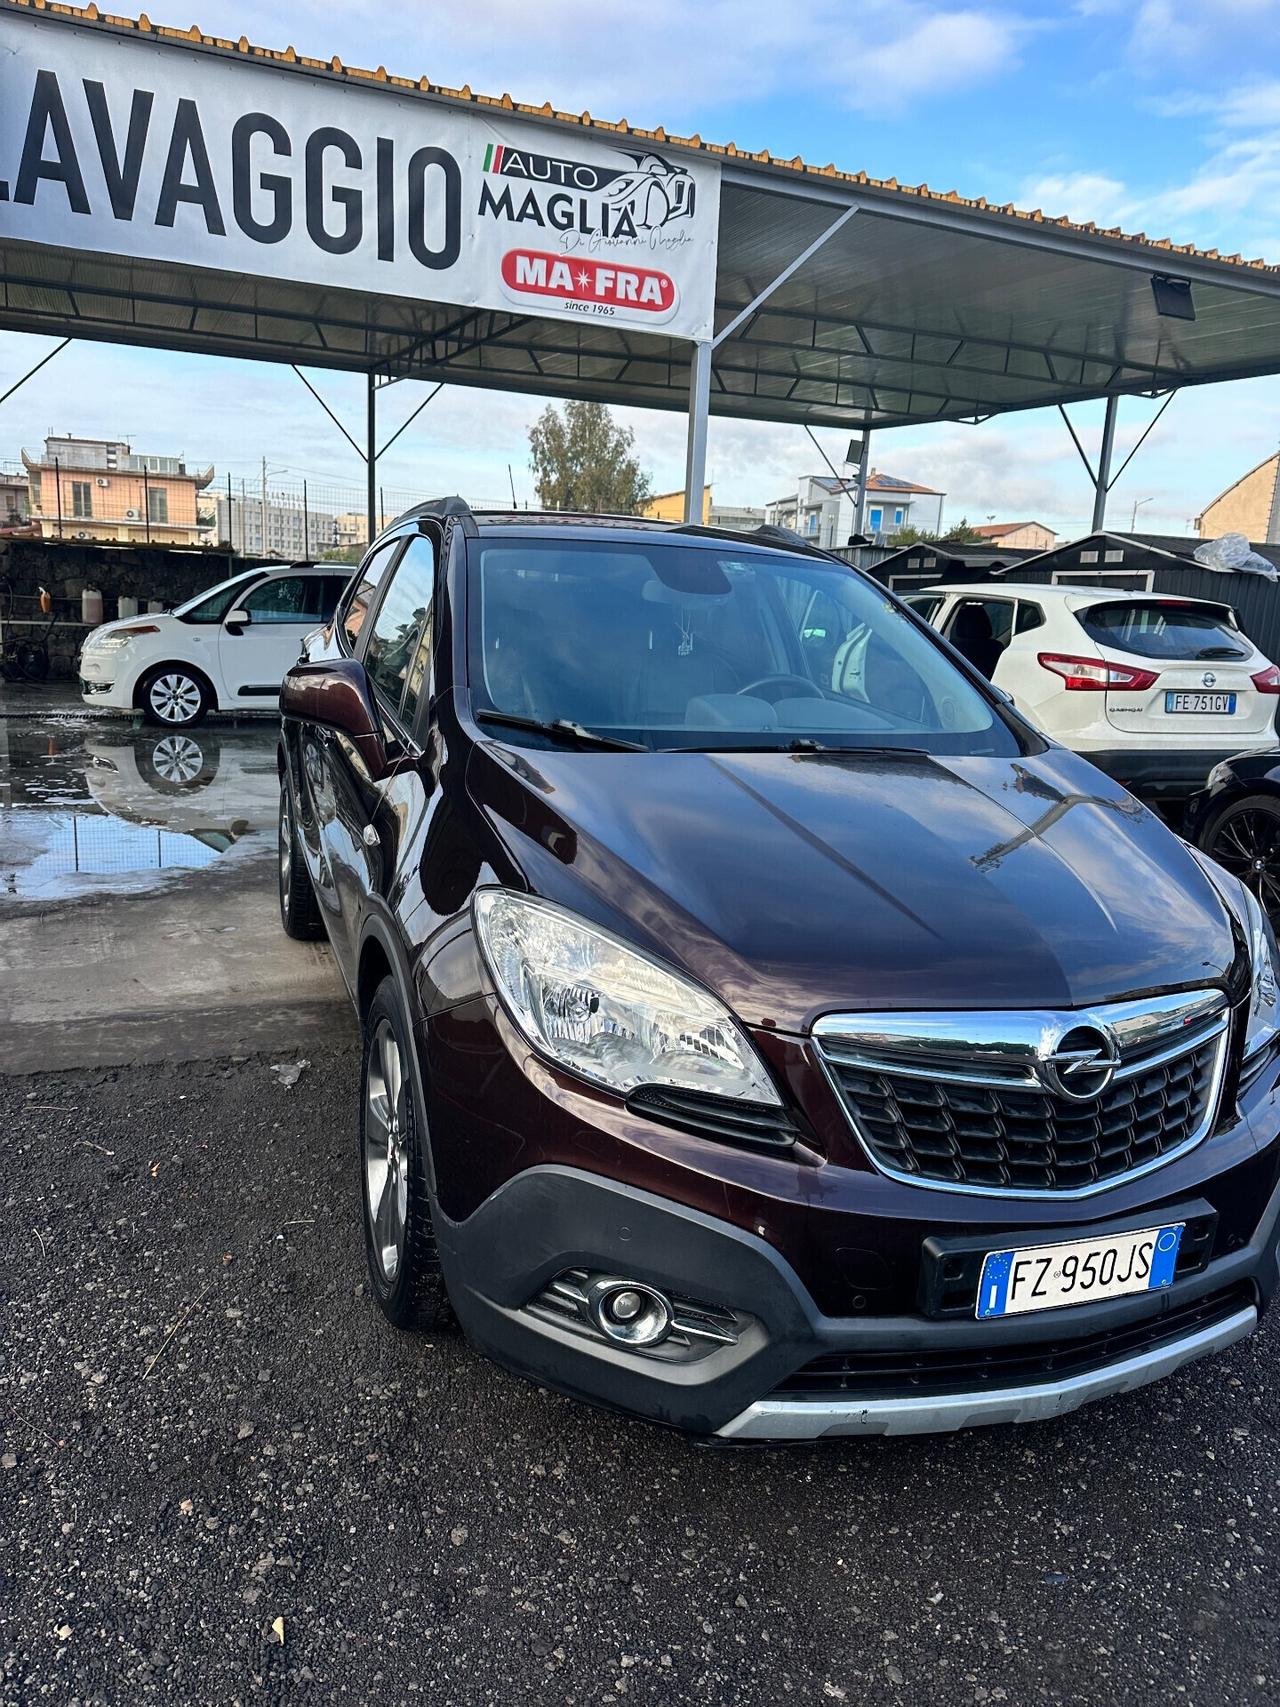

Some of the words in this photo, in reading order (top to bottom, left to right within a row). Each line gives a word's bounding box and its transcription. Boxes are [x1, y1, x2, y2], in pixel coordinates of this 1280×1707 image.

[0, 69, 462, 270] AVAGGIO
[502, 152, 598, 189] AUTO
[477, 178, 638, 238] MAGLIA
[564, 300, 590, 313] since
[592, 303, 616, 316] 1965
[1175, 695, 1190, 710] FE
[1011, 1258, 1051, 1300] FZ
[1060, 1242, 1154, 1293] 950JS
